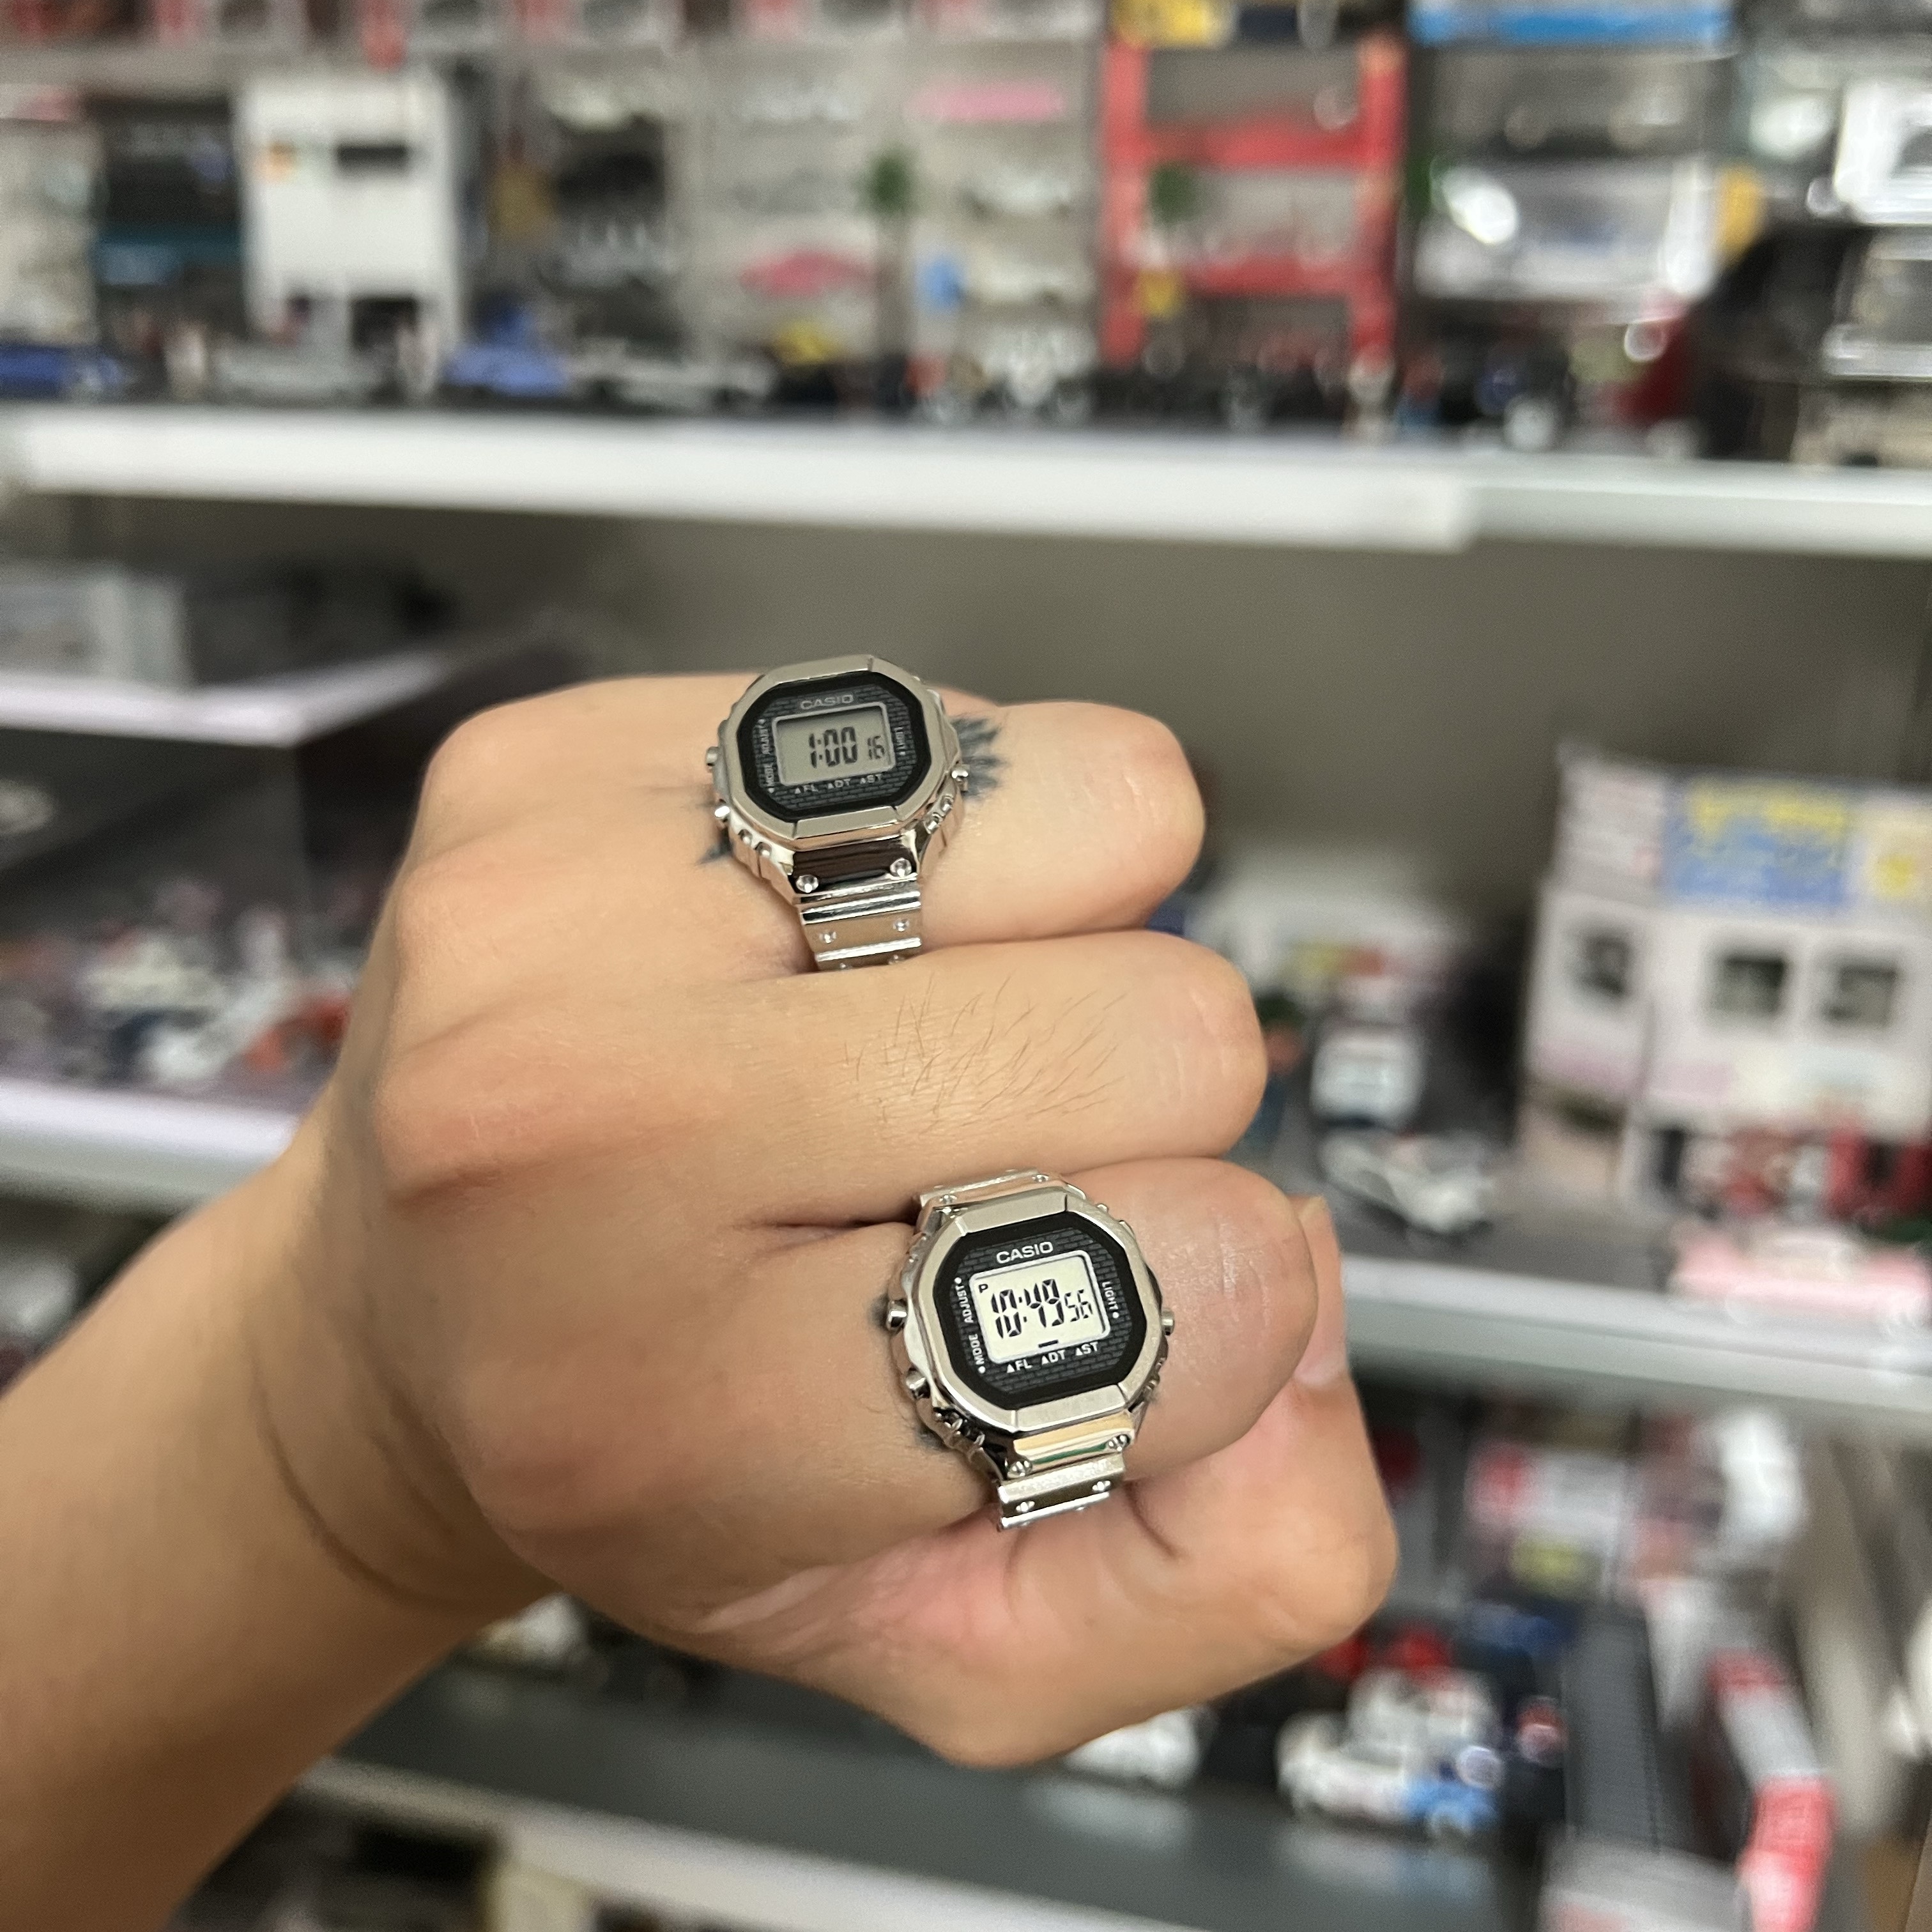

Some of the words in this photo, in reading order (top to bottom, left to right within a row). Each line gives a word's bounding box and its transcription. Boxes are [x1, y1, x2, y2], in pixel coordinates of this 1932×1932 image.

[801, 694, 854, 710] CASIO
[809, 726, 858, 769] 1:00
[867, 735, 885, 760] 16
[996, 1241, 1054, 1264] CASIO
[978, 1284, 988, 1294] P
[1102, 1282, 1119, 1310] LIGHT
[954, 1285, 974, 1324] ADJUST
[991, 1278, 1064, 1339] 10:49
[1064, 1289, 1093, 1322] 56
[969, 1333, 985, 1365] MODE
